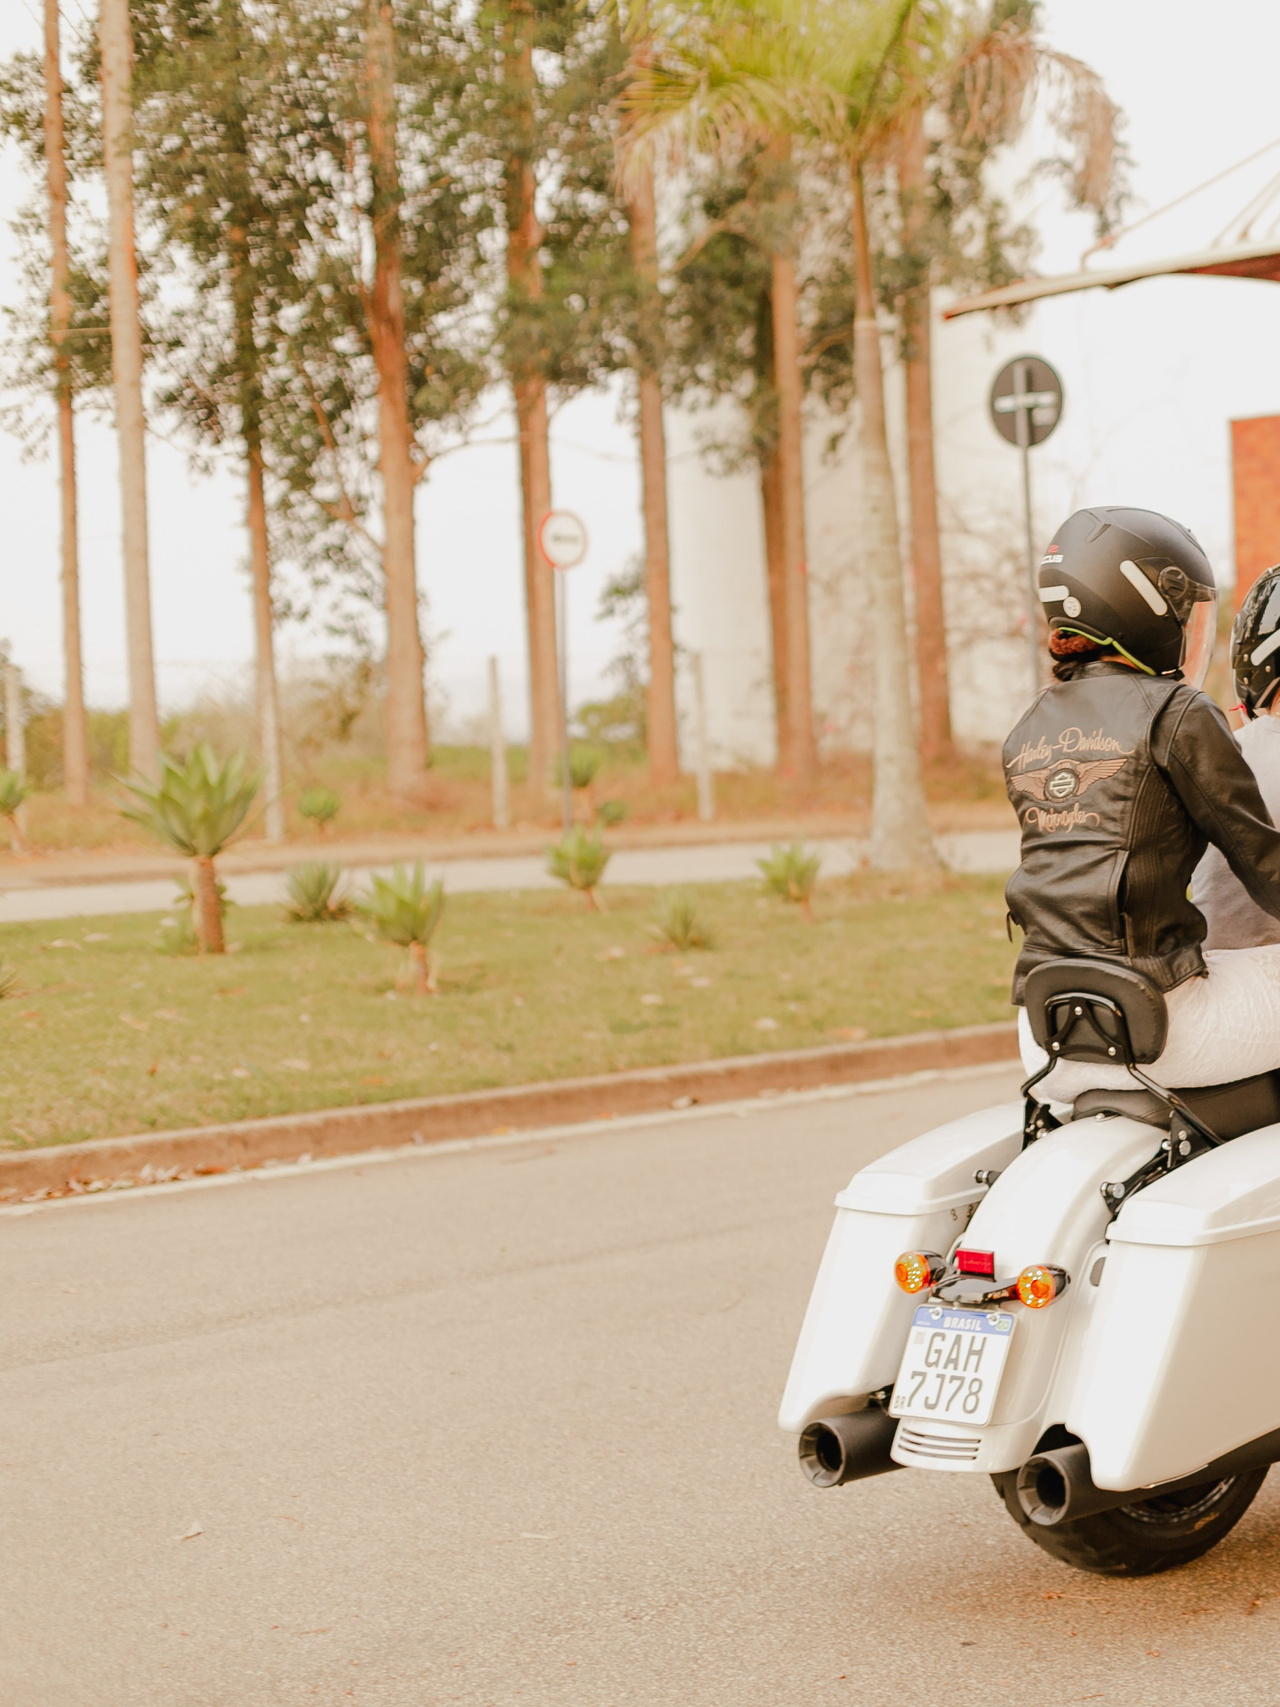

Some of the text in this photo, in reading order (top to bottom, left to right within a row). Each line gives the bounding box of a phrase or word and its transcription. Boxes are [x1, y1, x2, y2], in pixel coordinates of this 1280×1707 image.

[1005, 727, 1136, 771] Harley-Davidson
[943, 1317, 982, 1331] BRASIL
[924, 1331, 988, 1374] GAH
[906, 1371, 984, 1415] 7J78
